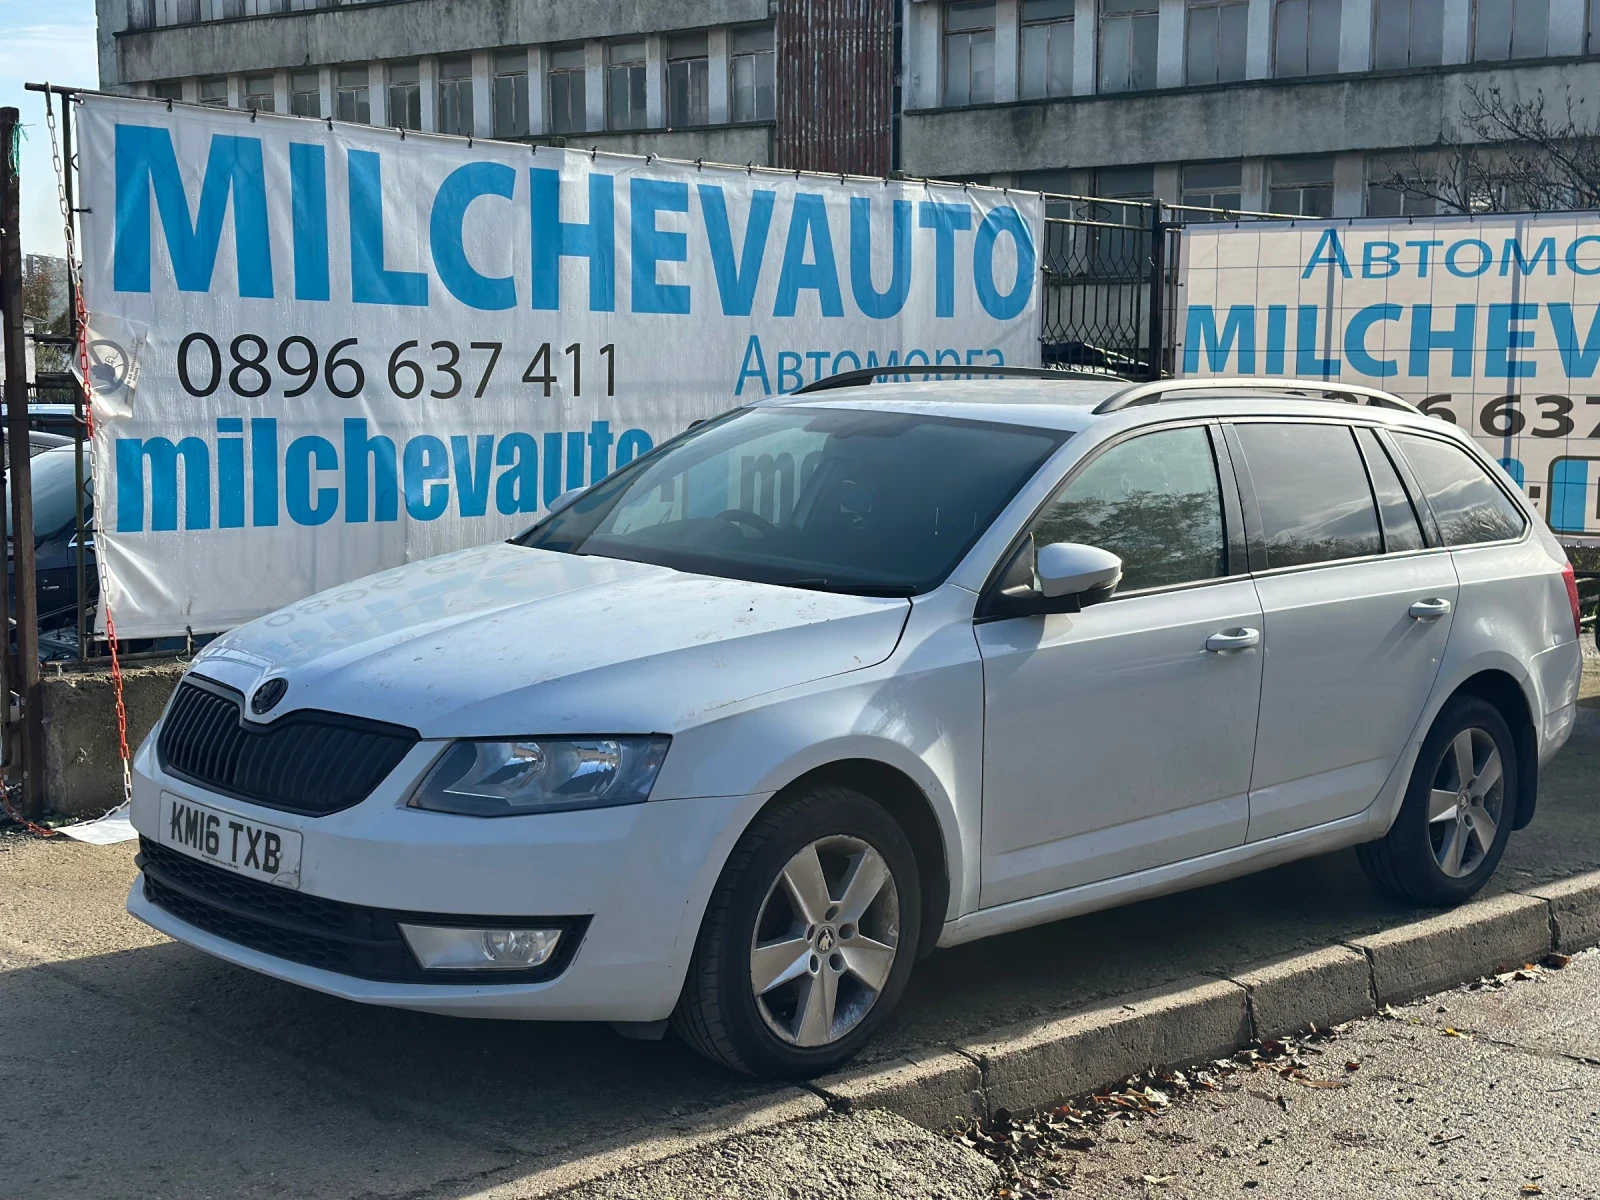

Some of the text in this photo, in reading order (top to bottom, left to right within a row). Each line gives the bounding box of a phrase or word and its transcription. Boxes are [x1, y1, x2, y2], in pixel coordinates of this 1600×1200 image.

[114, 124, 1034, 320] MILCHEVAUTO
[178, 333, 365, 399] 0896
[388, 340, 502, 399] 637
[522, 343, 615, 397] 411
[1183, 303, 1600, 378] MILCHEV
[171, 801, 281, 874] KM16 TXB
